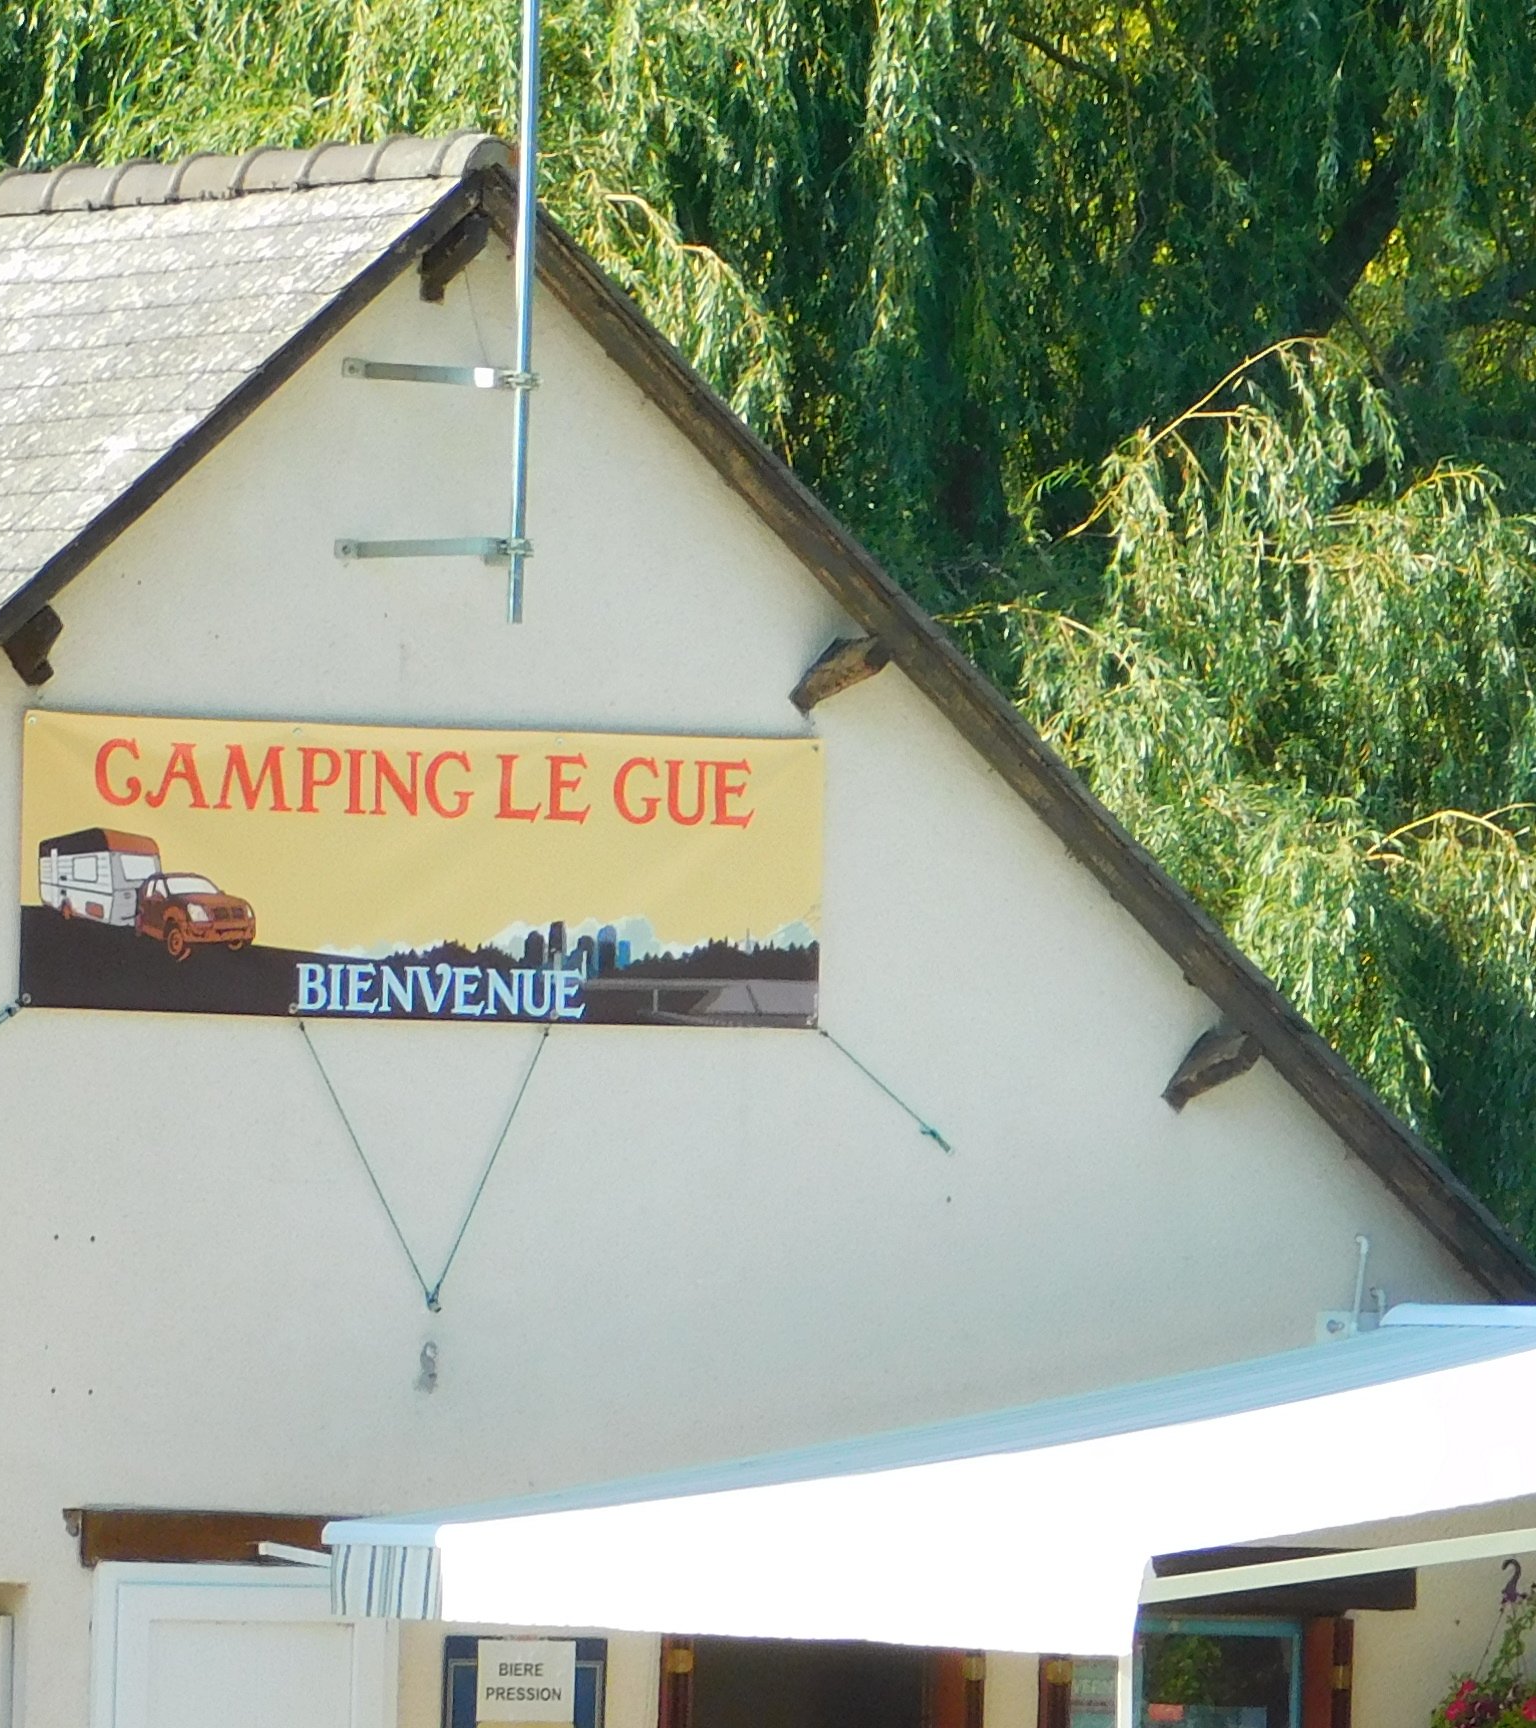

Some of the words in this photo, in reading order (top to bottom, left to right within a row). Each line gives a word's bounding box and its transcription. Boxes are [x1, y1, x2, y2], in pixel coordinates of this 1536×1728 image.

[95, 738, 475, 819] CAMPING
[494, 753, 591, 825] LE
[613, 756, 756, 829] GUE
[296, 962, 587, 1020] BIENVENUE
[498, 1662, 544, 1677] BIERE
[485, 1686, 562, 1701] PRESSION
